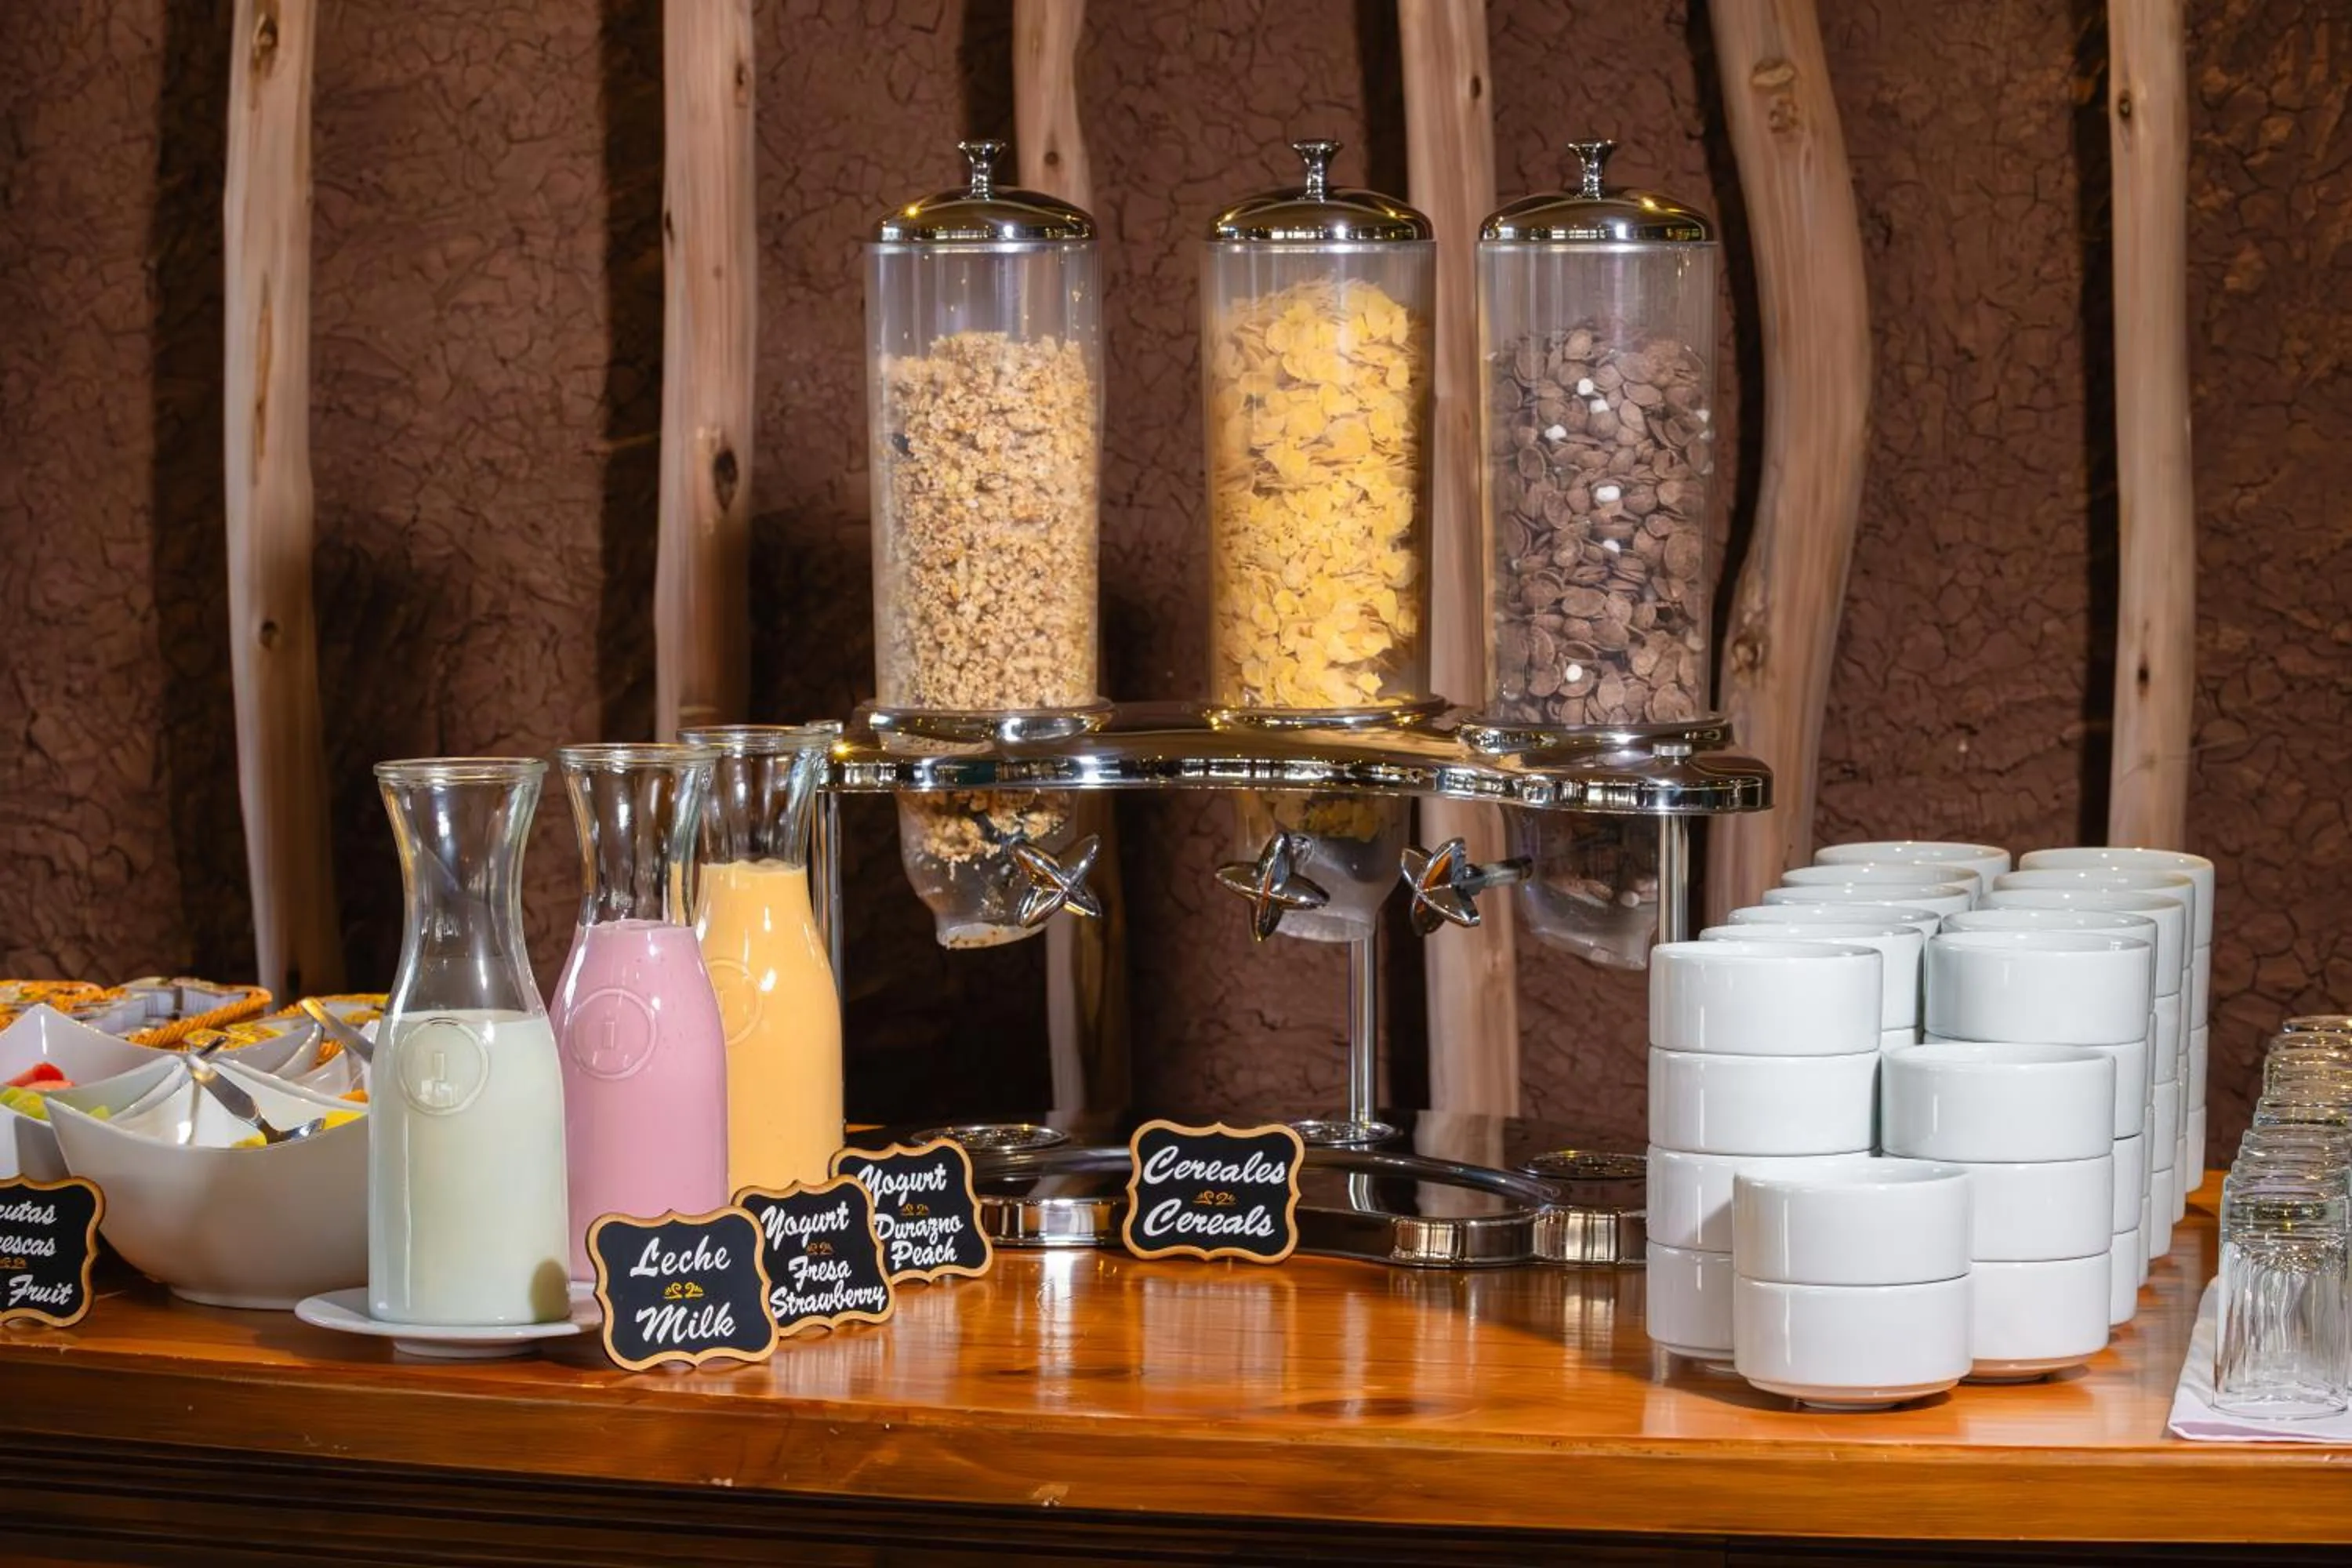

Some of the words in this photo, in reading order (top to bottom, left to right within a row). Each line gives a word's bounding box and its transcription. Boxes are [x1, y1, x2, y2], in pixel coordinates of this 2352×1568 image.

[1142, 1145, 1287, 1185] Cereales
[858, 1163, 946, 1207] Yogurt
[760, 1200, 850, 1250] Yogurt
[873, 1213, 964, 1245] Durazno
[1143, 1198, 1275, 1237] Cereals
[0, 1235, 56, 1257] escas
[630, 1235, 731, 1278] Leche
[891, 1236, 958, 1270] Peach
[8, 1274, 73, 1306] Fruit
[788, 1255, 852, 1292] Fresa
[770, 1279, 886, 1319] Strawberry
[635, 1301, 736, 1344] Milk
